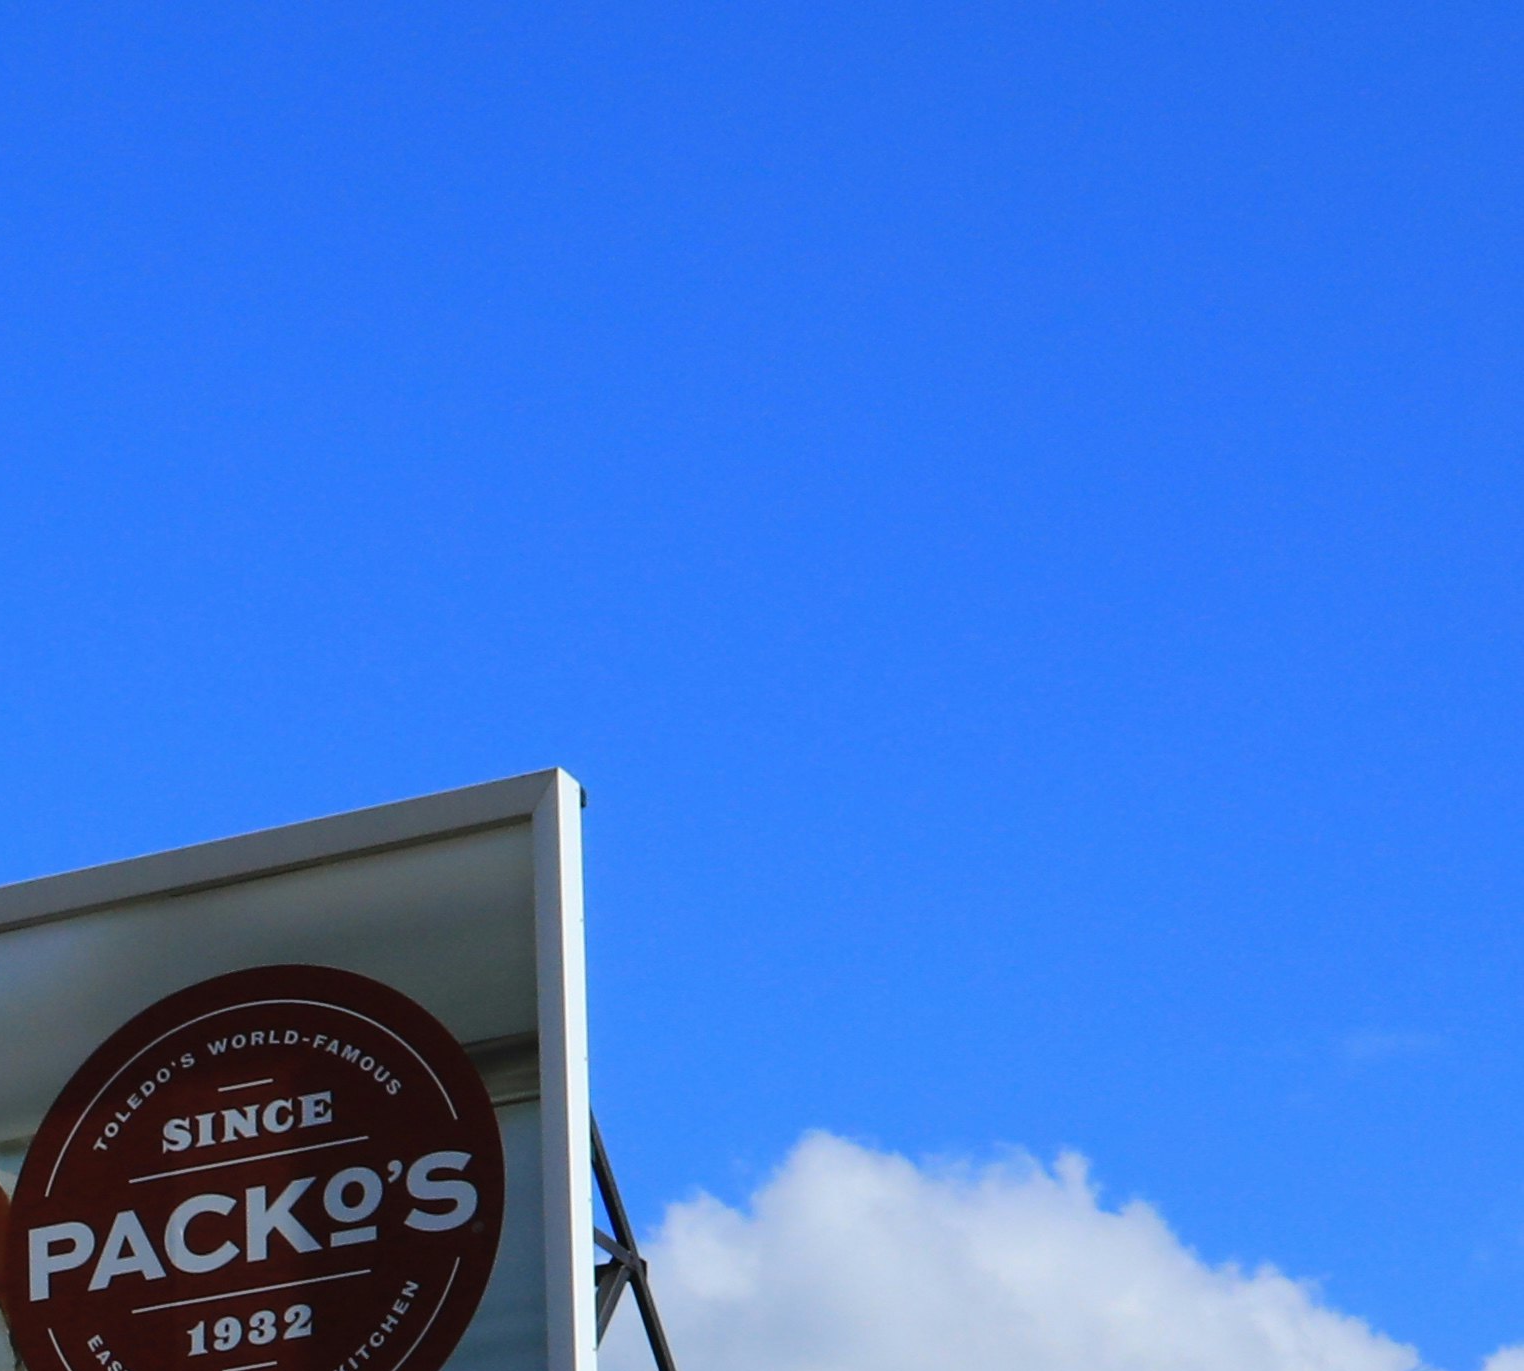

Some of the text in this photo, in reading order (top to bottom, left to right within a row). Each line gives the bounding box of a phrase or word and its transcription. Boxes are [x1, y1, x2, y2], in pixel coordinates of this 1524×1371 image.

[93, 1028, 401, 1153] TOLEDO'S WORLD-FAMOUS
[161, 1090, 334, 1153] SINCE
[186, 1303, 313, 1357] 1932
